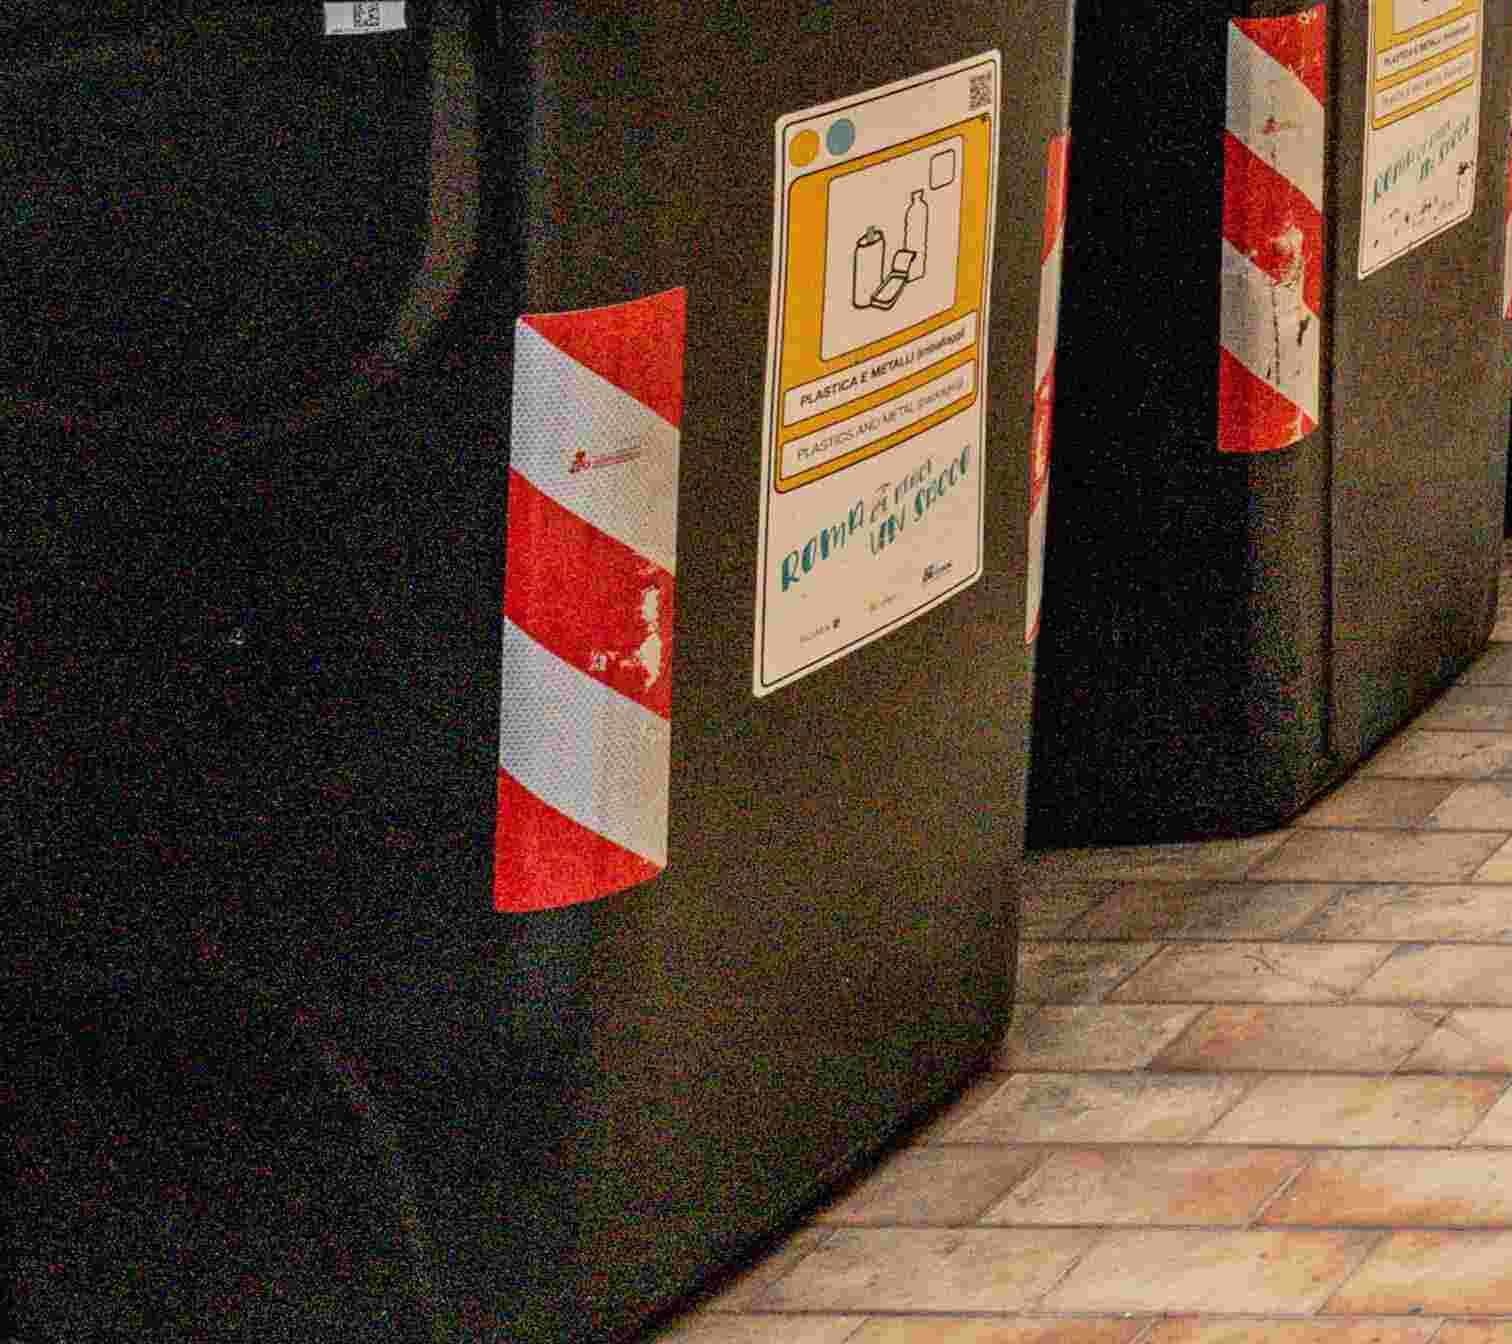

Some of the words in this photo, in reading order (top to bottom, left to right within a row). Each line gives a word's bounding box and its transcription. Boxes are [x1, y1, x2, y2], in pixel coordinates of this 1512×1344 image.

[799, 376, 860, 408] PLASTICA
[860, 369, 870, 384] E
[870, 349, 915, 381] METALLI
